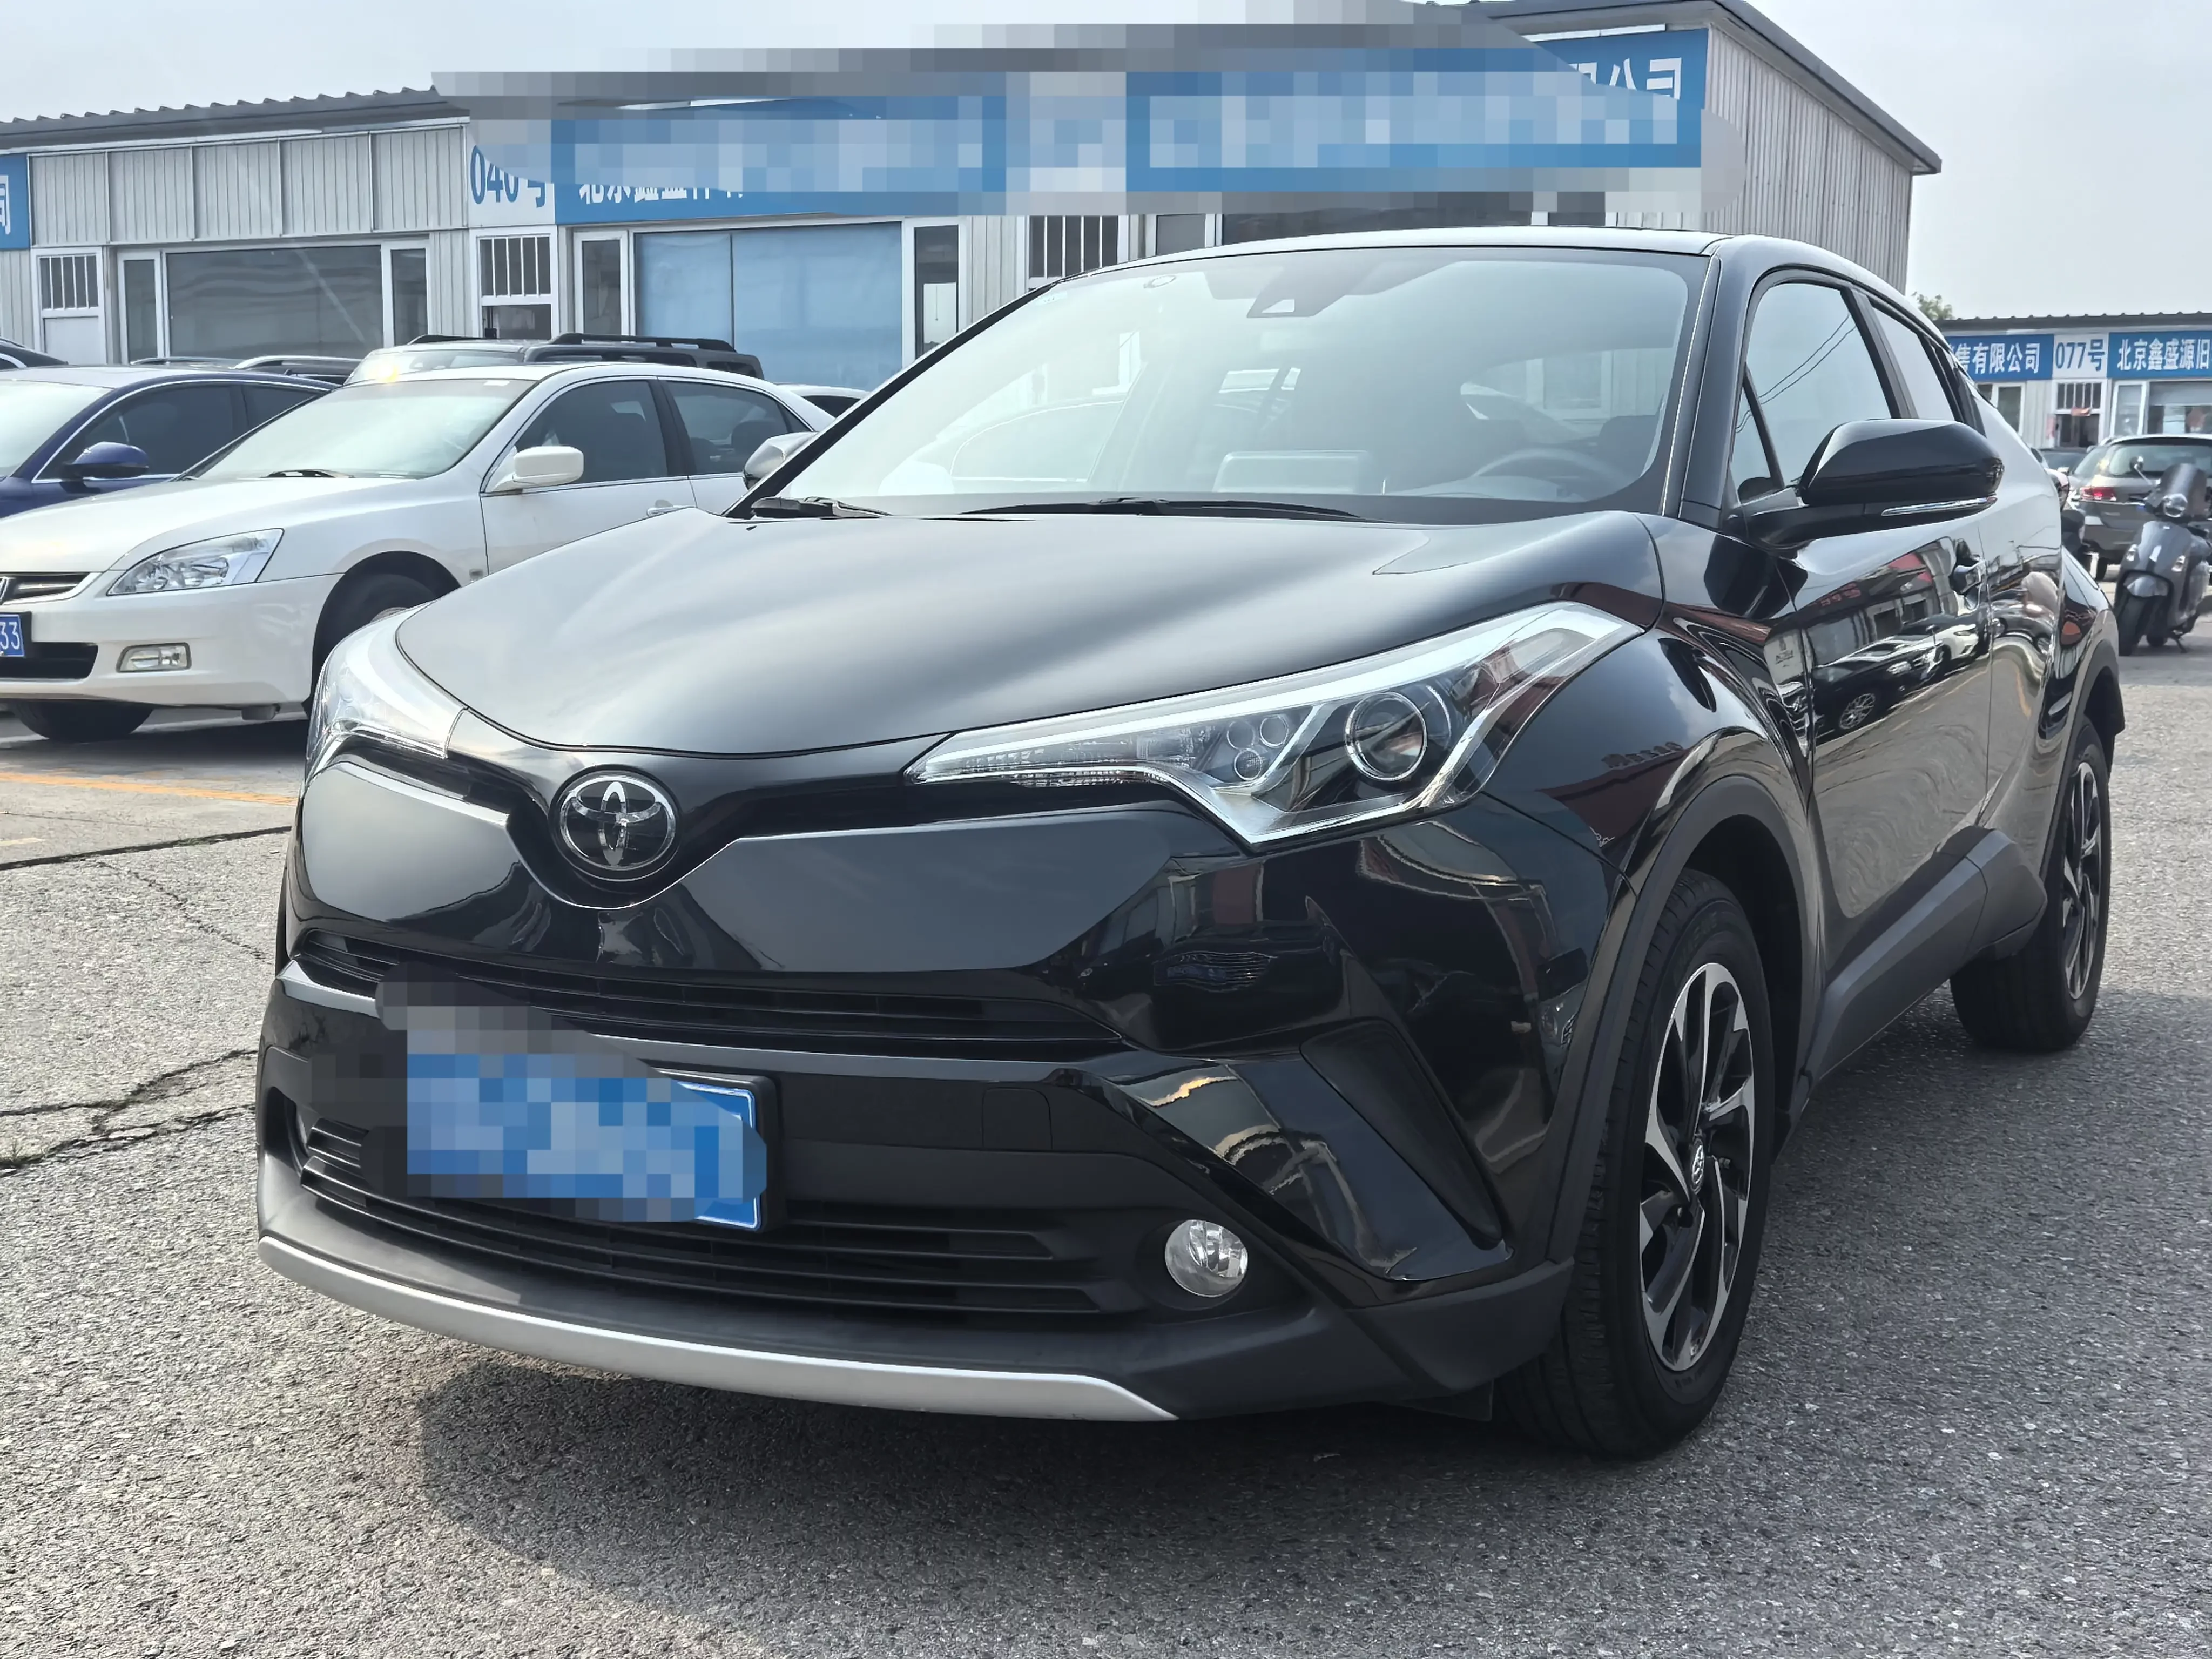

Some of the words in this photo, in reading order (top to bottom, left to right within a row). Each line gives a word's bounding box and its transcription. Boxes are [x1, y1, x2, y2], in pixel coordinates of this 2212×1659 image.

[1950, 342, 2040, 374] 售有限公司
[2055, 339, 2105, 372] 077号
[2117, 338, 2210, 371] 北京鑫盛源旧
